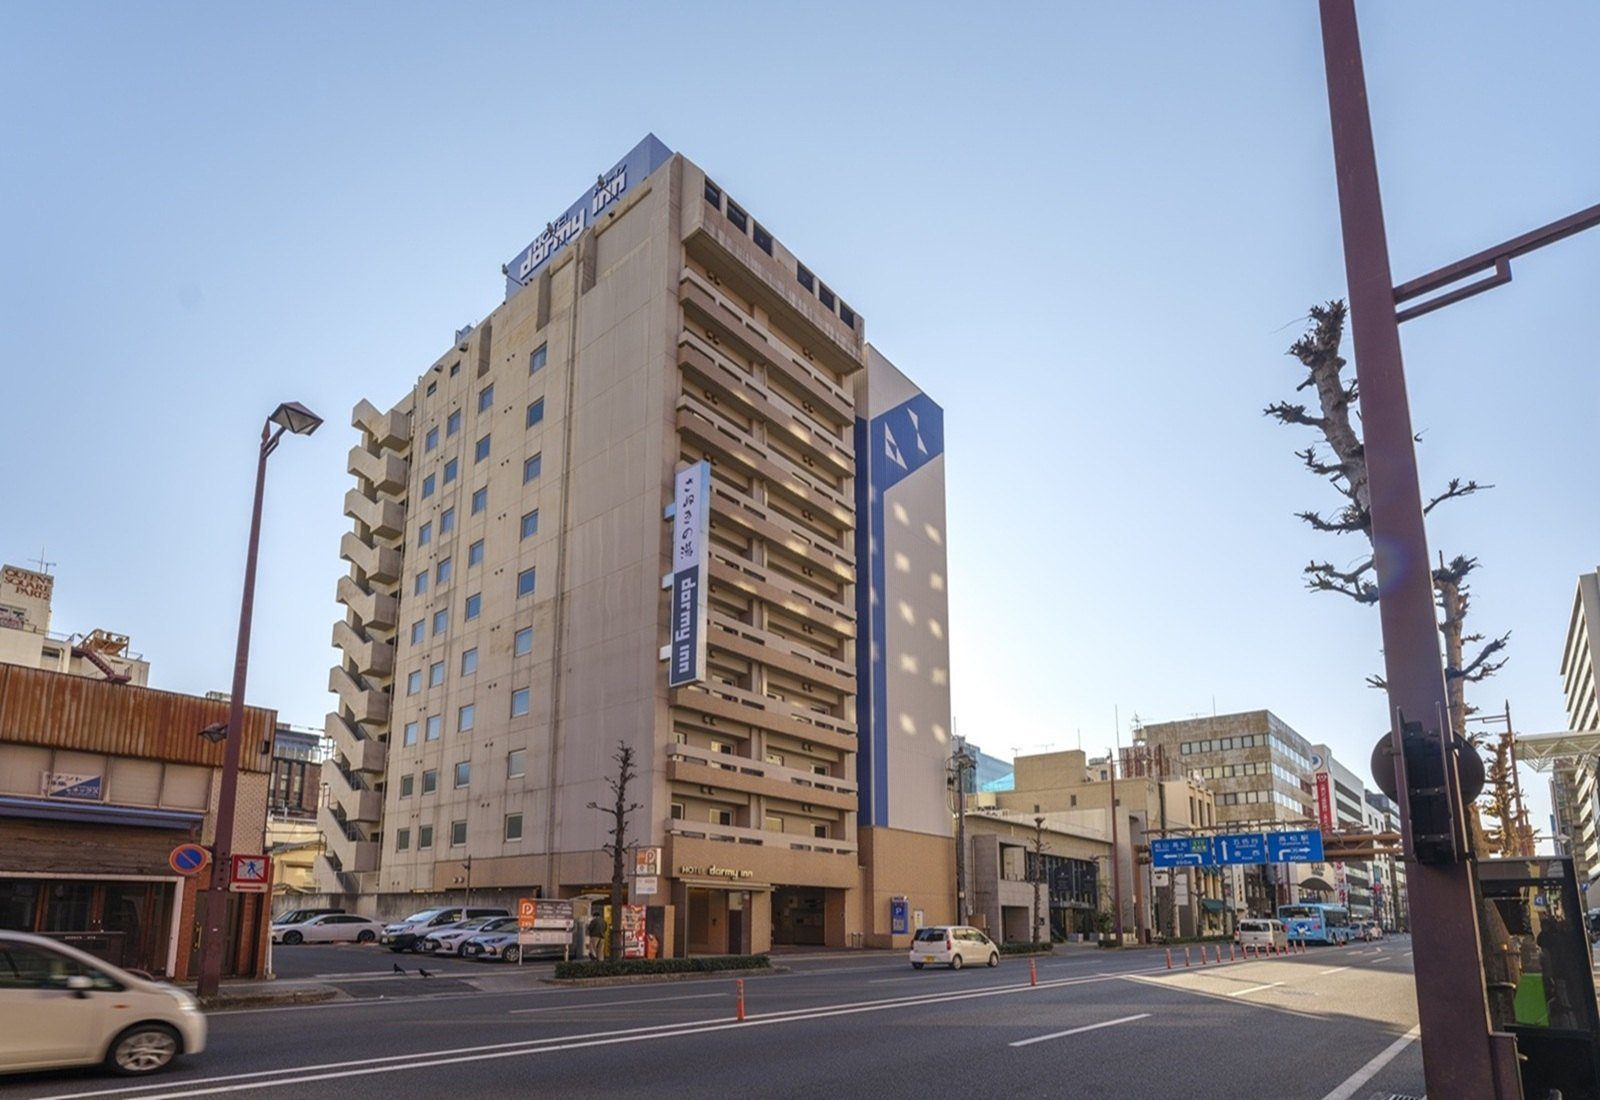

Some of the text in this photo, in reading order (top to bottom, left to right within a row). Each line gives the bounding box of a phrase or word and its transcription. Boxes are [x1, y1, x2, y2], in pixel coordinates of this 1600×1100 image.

[519, 208, 587, 281] dormy
[592, 171, 628, 217] inn
[675, 577, 696, 673] dormy inn
[708, 864, 738, 880] dormy
[739, 870, 753, 878] inn
